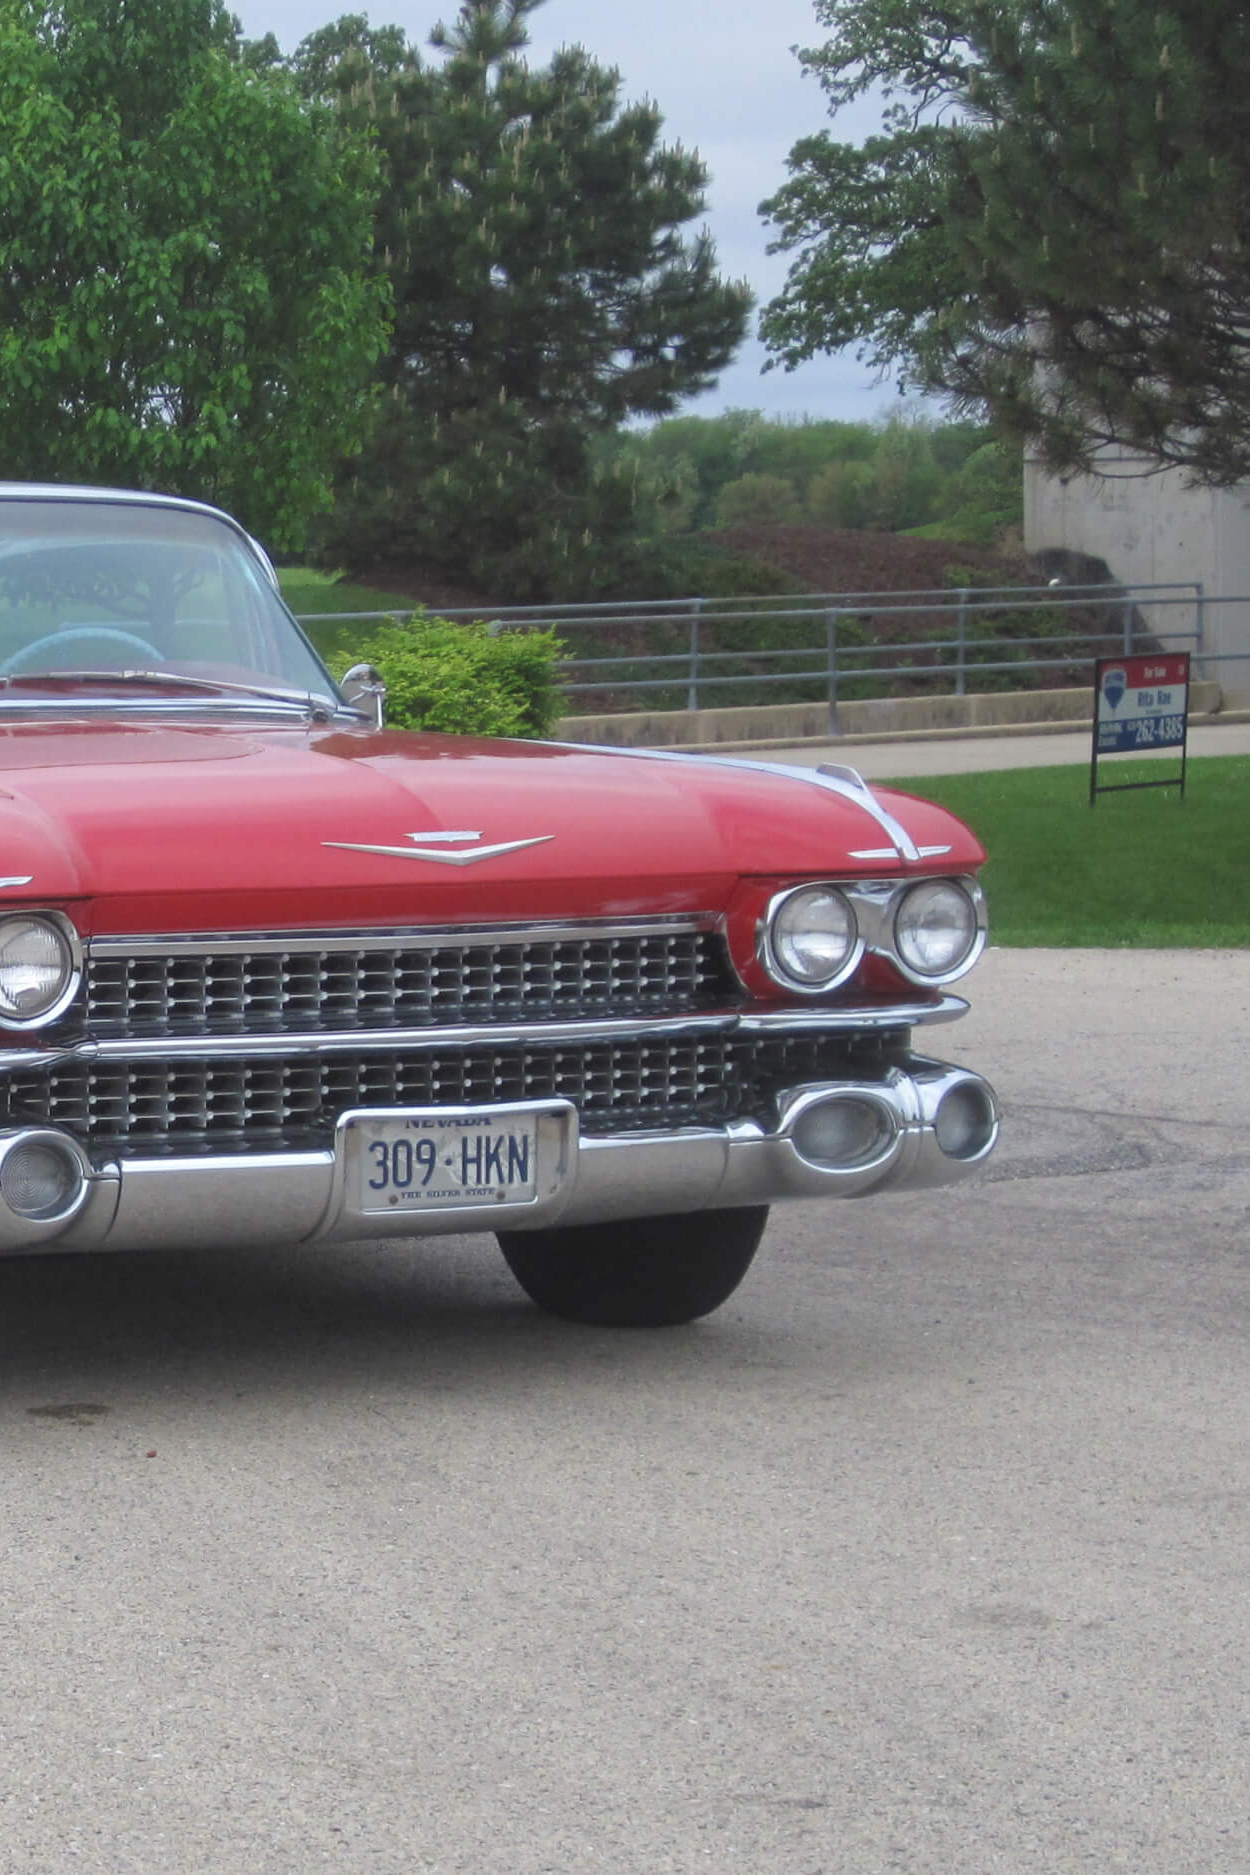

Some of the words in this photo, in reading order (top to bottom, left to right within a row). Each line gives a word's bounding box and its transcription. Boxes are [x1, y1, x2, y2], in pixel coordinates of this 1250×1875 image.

[401, 1191, 422, 1200] THE
[426, 1189, 461, 1199] SILVER
[465, 1187, 495, 1197] STATE
